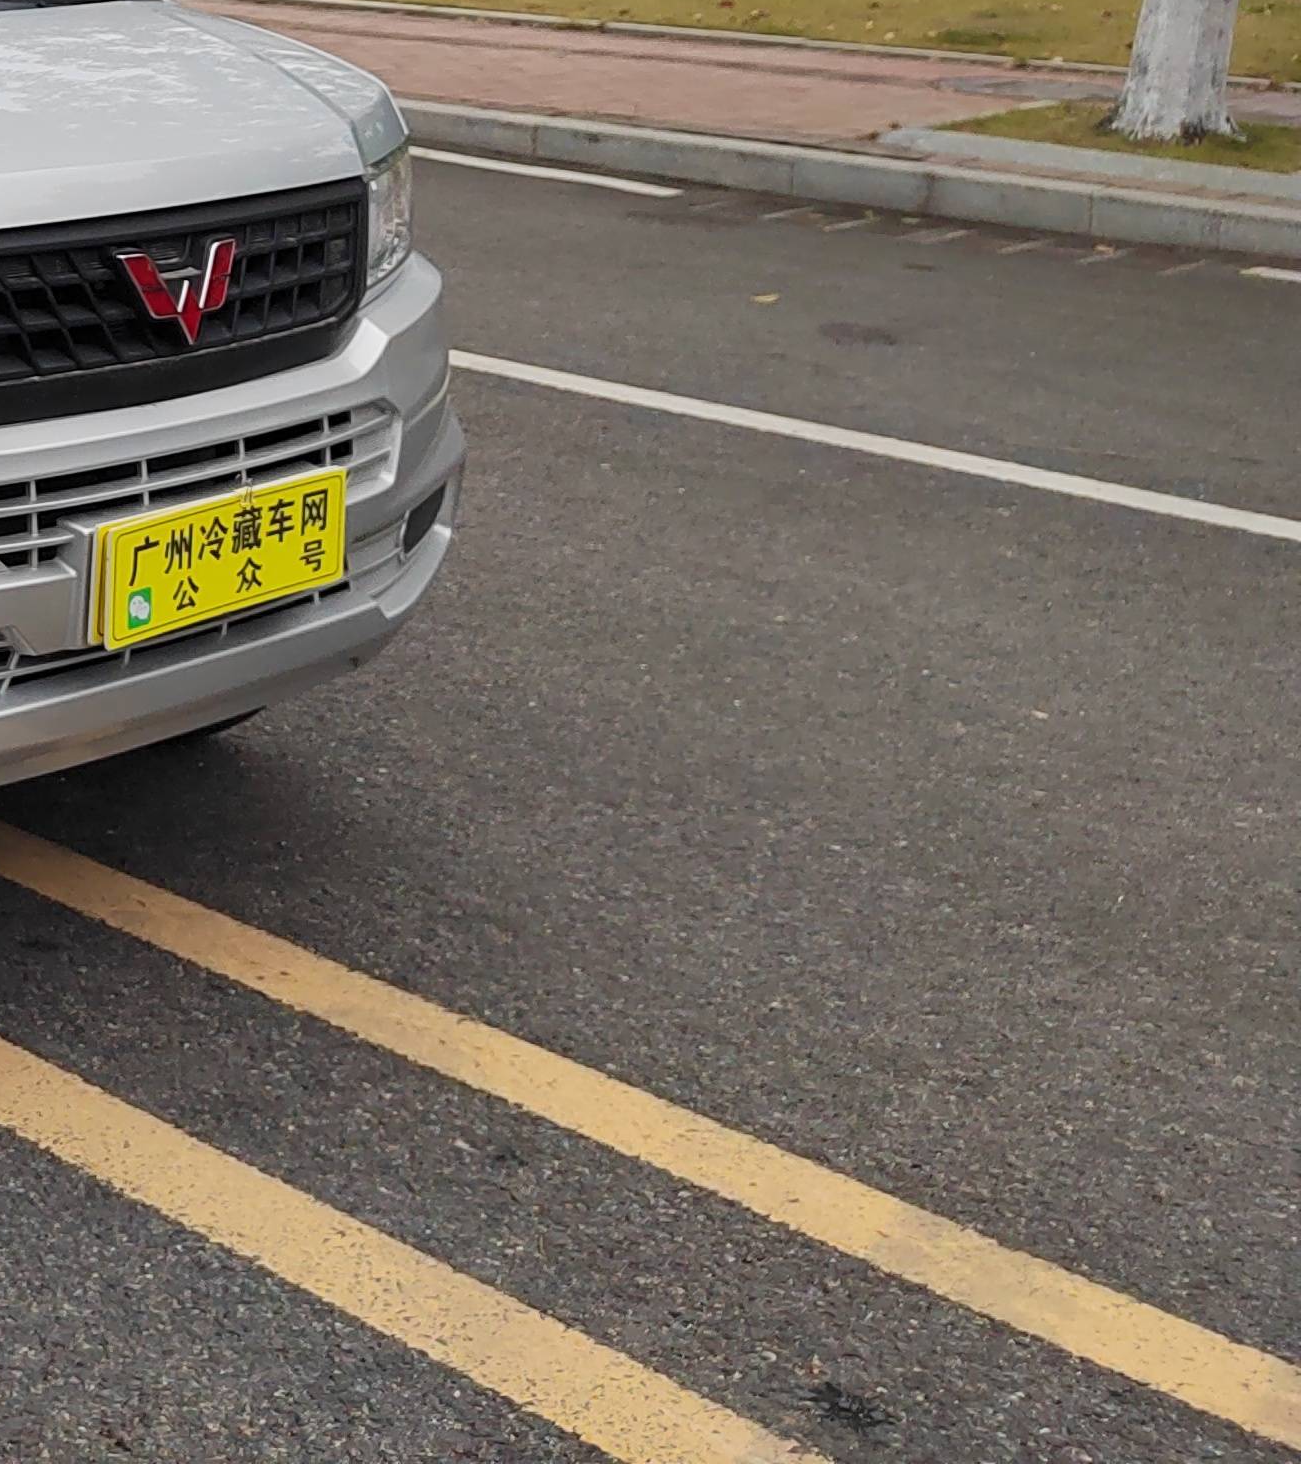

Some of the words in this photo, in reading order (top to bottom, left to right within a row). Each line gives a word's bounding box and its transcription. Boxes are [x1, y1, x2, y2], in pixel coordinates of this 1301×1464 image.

[128, 488, 329, 587] 广州冷藏车网
